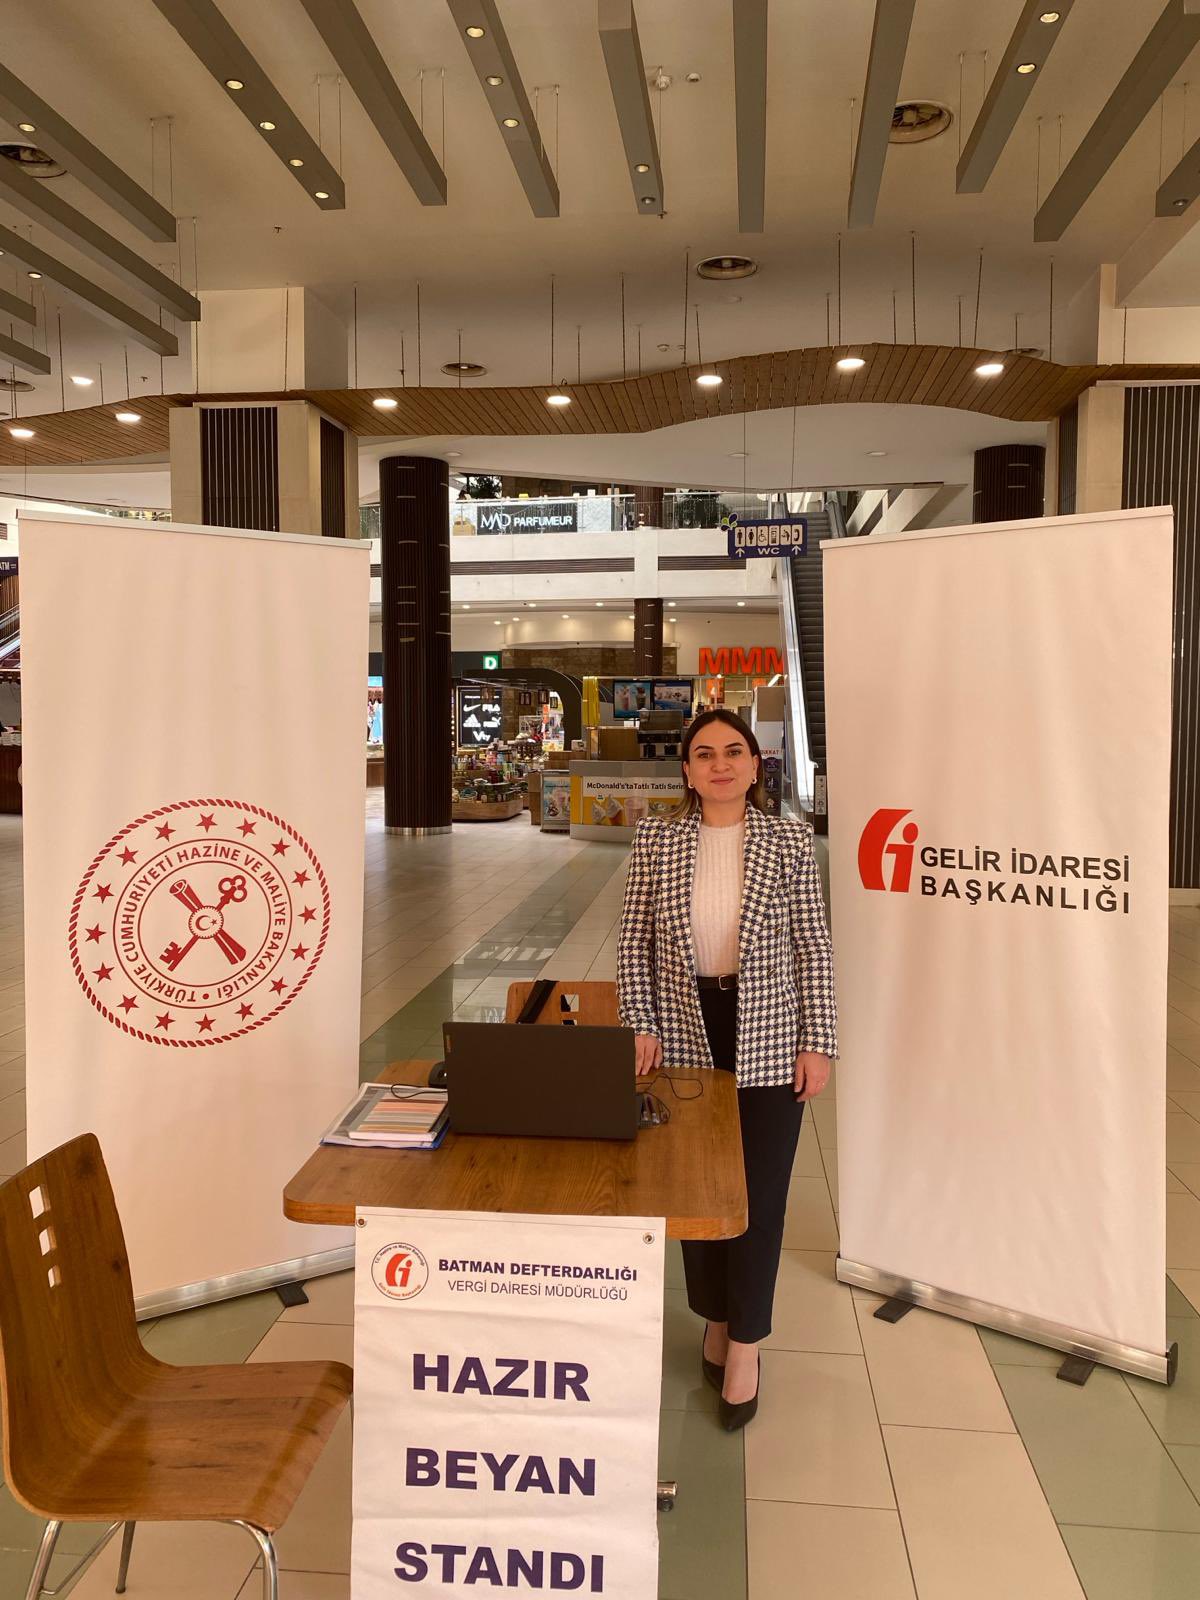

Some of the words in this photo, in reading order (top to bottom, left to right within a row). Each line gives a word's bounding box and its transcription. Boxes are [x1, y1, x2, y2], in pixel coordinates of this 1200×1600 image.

[513, 515, 573, 527] PARFUMEUR
[757, 547, 780, 555] WC
[176, 842, 241, 863] HAZİNE
[244, 854, 263, 872] VE
[920, 845, 1002, 873] GELİR
[1011, 847, 1130, 883] İDARESİ
[120, 854, 174, 963] CUMHURİYETİ
[260, 871, 287, 925] MALİYE
[920, 874, 1130, 914] BAŞKANLIĞI
[133, 964, 197, 1004] TÜRKİYE
[217, 931, 283, 998] BAKANLIĞI
[438, 1258, 505, 1275] BATMAN
[510, 1263, 637, 1281] DEFTERDARLIĞI
[448, 1279, 487, 1293] VERGİ
[491, 1281, 541, 1296] DAİRESİ
[545, 1284, 628, 1301] MÜDÜRLÜĞÜ
[413, 1353, 590, 1402] HAZIR
[405, 1447, 596, 1497] BEYAN
[394, 1541, 604, 1593] STANDI
